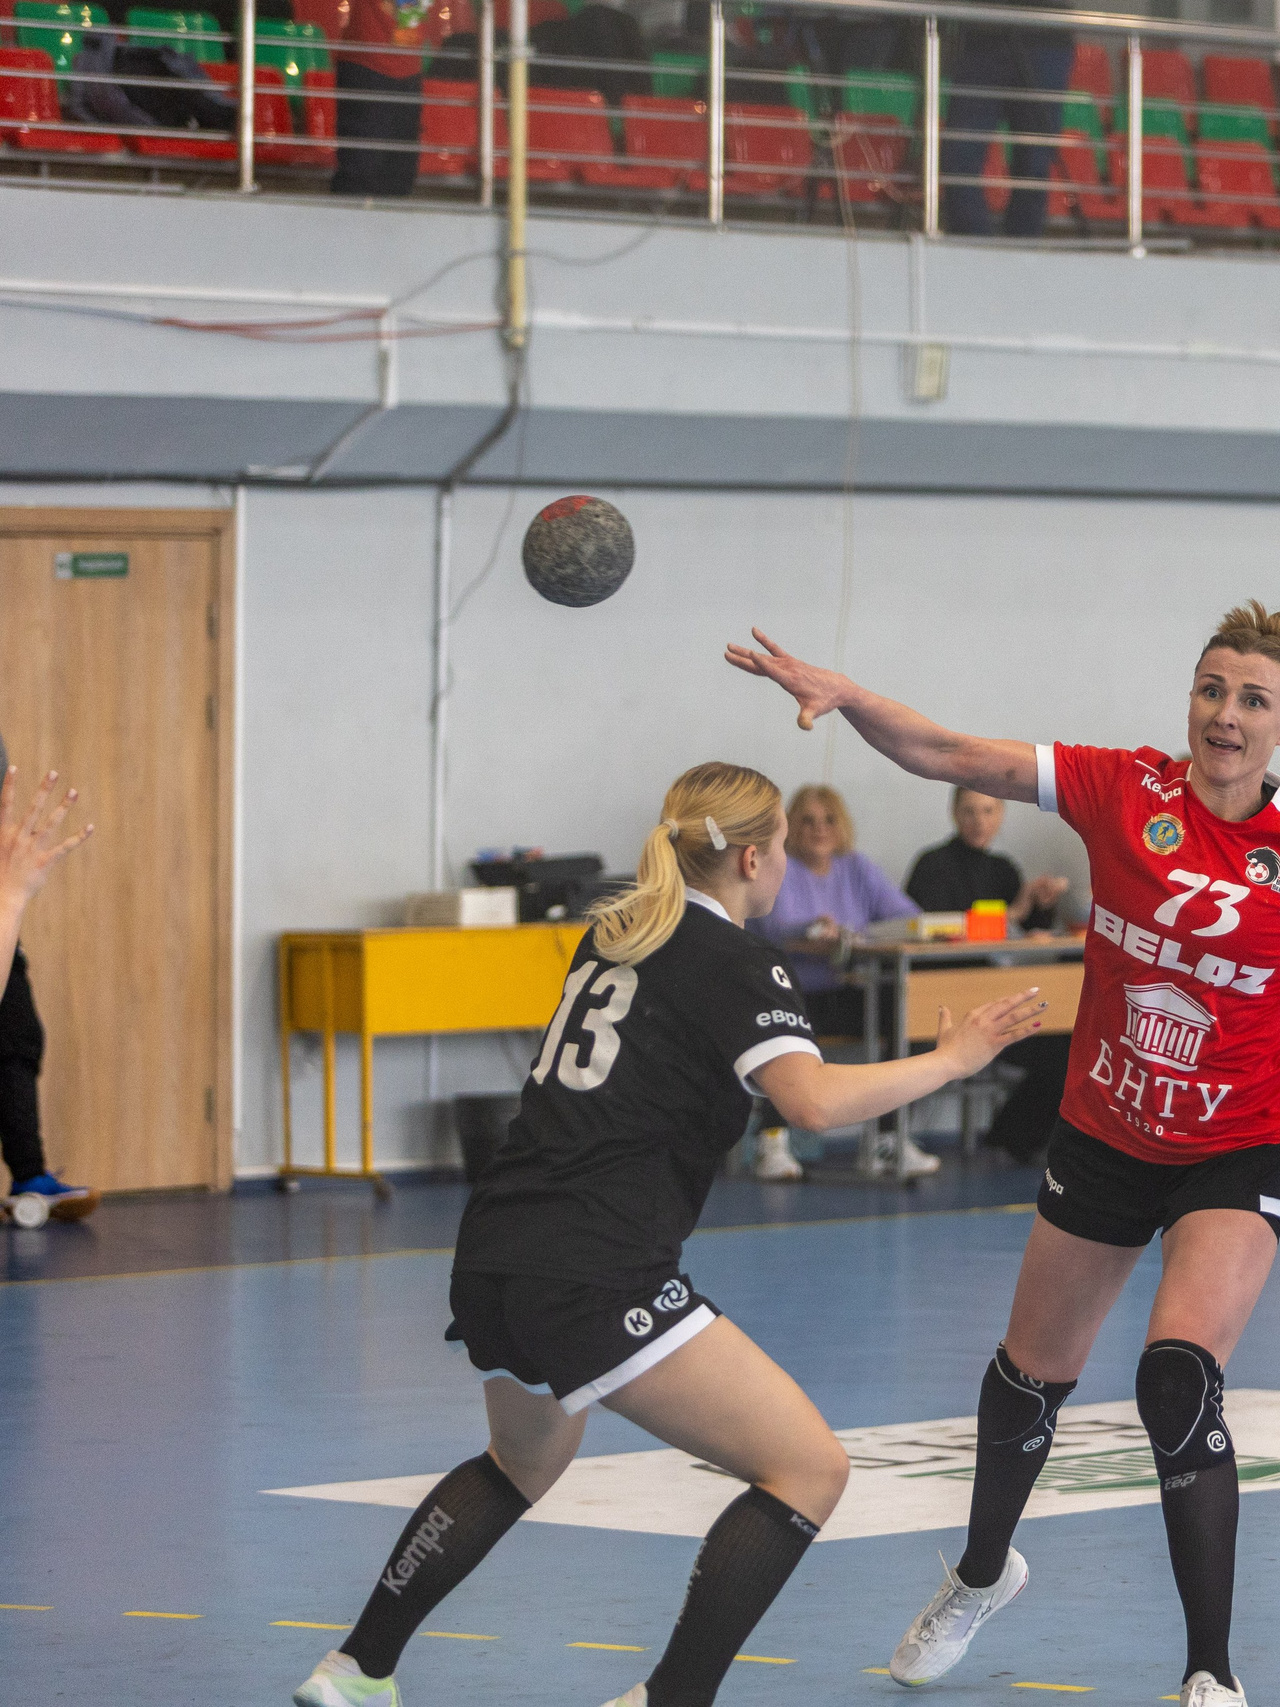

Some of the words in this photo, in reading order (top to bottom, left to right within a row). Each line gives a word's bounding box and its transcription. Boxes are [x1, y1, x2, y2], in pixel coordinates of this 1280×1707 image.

[1153, 868, 1250, 937] 73
[1093, 904, 1276, 995] BELAZ
[531, 960, 639, 1091] 13
[1089, 1039, 1232, 1122] БНТУ
[1126, 1111, 1164, 1137] 1920
[381, 1505, 455, 1595] Kempa
